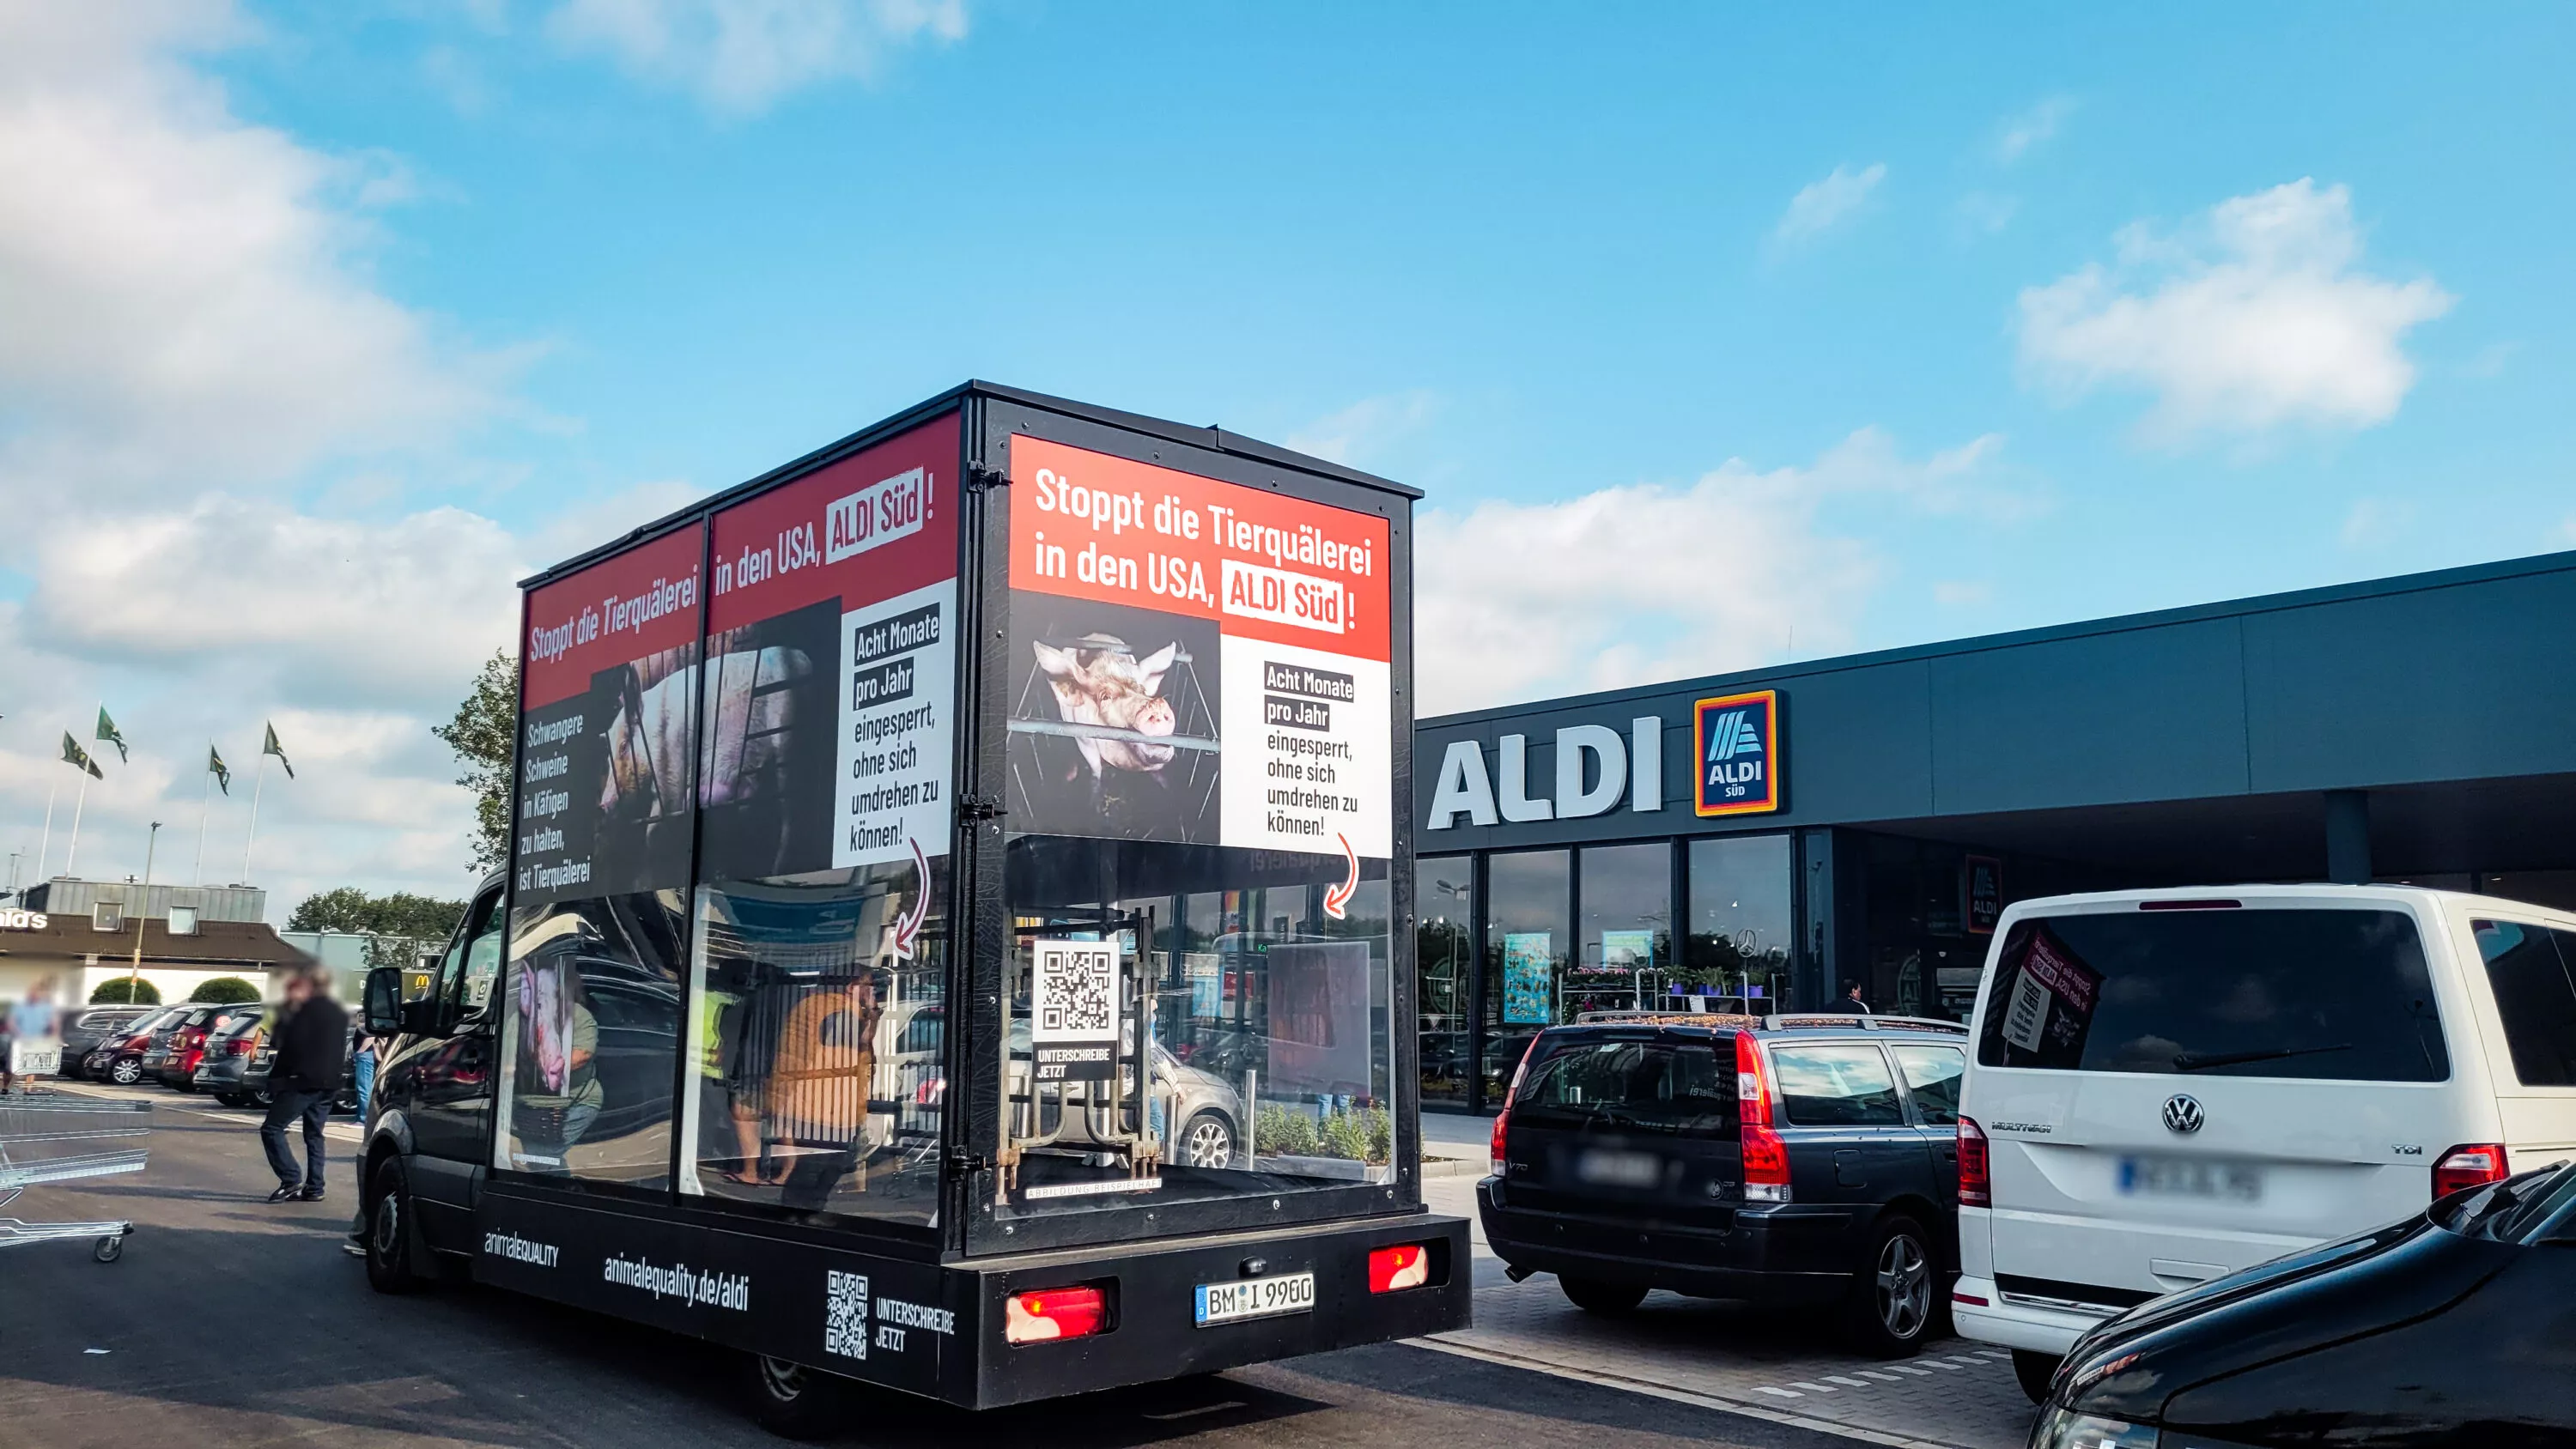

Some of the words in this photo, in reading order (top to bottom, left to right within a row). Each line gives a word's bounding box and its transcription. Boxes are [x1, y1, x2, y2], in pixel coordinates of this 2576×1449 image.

[1036, 469, 1145, 535] Stoppt
[1154, 494, 1200, 540] die
[1207, 504, 1371, 577] Tierquälerei
[531, 616, 574, 664] Stoppt
[577, 605, 598, 645] die
[604, 564, 698, 635] Tierquälerei
[715, 555, 732, 597] in
[738, 545, 772, 589] den
[778, 522, 820, 574] USA,
[831, 497, 874, 553] ALDI
[1036, 530, 1066, 578] in
[1078, 542, 1137, 591] den
[1148, 552, 1214, 609] USA,
[1230, 569, 1285, 615] ALDI
[857, 627, 886, 660] Acht
[890, 614, 939, 650] Monate
[856, 678, 877, 709] pro
[881, 664, 912, 695] Jahr
[1267, 665, 1300, 691] Acht
[1303, 671, 1353, 700] Monate
[855, 701, 935, 746] eingesperrt,
[1267, 703, 1291, 724] pro
[1295, 702, 1328, 726] Jahr
[528, 714, 583, 748] Schwangere
[1267, 730, 1352, 761] eingesperrt,
[526, 751, 568, 783] Schweine
[854, 751, 884, 779] ohne
[889, 741, 916, 772] sich
[1267, 758, 1303, 779] ohne
[1307, 761, 1335, 784] sich
[1427, 716, 1662, 830] ALDI
[1709, 761, 1761, 785] ALDI
[524, 795, 532, 819] in
[534, 788, 568, 820] Käfigen
[852, 780, 918, 815] umdrehen
[922, 780, 939, 803] zu
[1267, 787, 1339, 811] umdrehen
[1343, 797, 1358, 813] zu
[1725, 784, 1745, 797] SÜD
[850, 817, 902, 852] können!
[1267, 809, 1324, 836] können!
[521, 837, 532, 855] zu
[534, 827, 564, 851] halten,
[519, 866, 532, 892] ist
[533, 855, 591, 893] Tierquälerei
[1973, 900, 1997, 915] ALDI
[1037, 1065, 1066, 1078] JETZT
[1038, 1048, 1110, 1063] UNTERSCHREIBE
[2391, 1143, 2422, 1155] TDI
[1028, 1185, 1090, 1197] ABBILDUNG
[1094, 1179, 1162, 1192] BEISPIELHAFT
[484, 1227, 559, 1268] animalEQUALITY
[605, 1252, 749, 1312] animalequality.de/aldi
[877, 1297, 955, 1335] UNTERSCHREIBE
[1210, 1288, 1235, 1315] BM
[876, 1325, 906, 1352] JETZT
